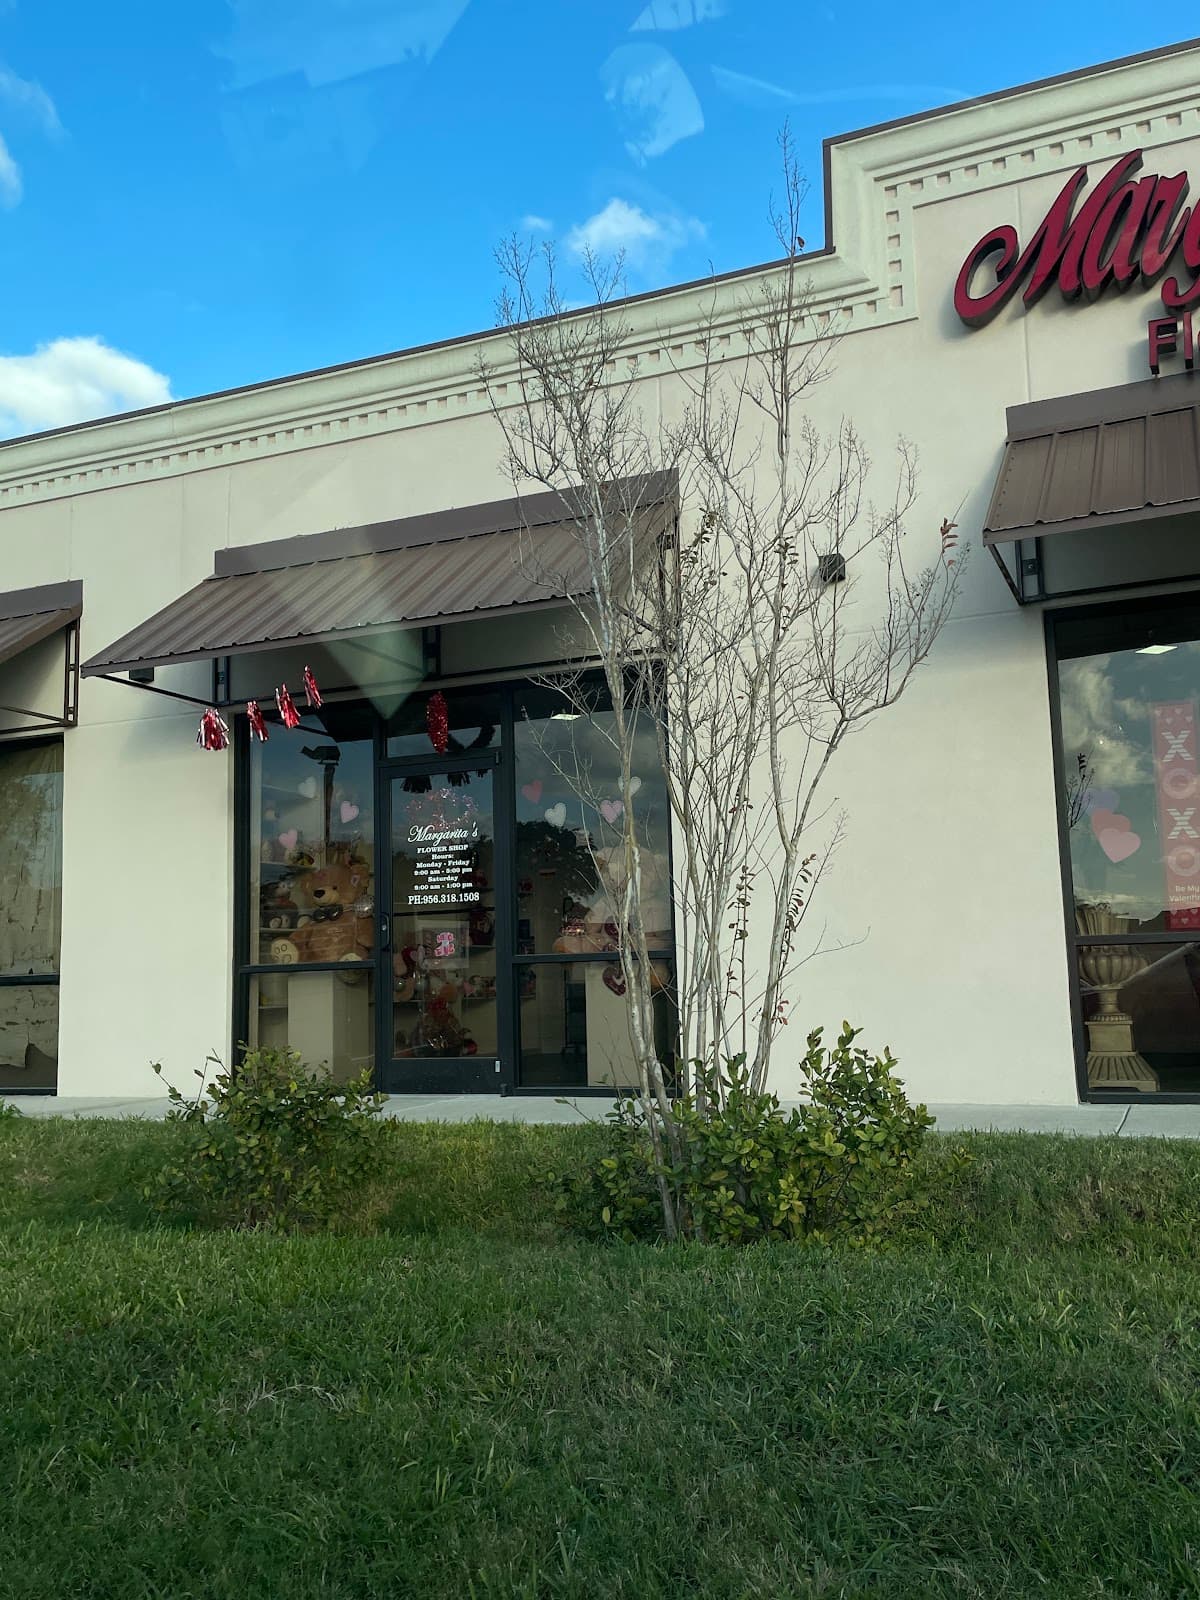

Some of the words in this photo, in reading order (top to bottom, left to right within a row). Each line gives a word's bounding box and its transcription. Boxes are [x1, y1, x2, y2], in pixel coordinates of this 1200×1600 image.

[417, 846, 447, 854] FLOWER
[416, 861, 442, 869] Monday
[447, 859, 470, 867] Friday
[427, 875, 459, 883] Saturday
[407, 891, 480, 905] PH:956.318.1508
